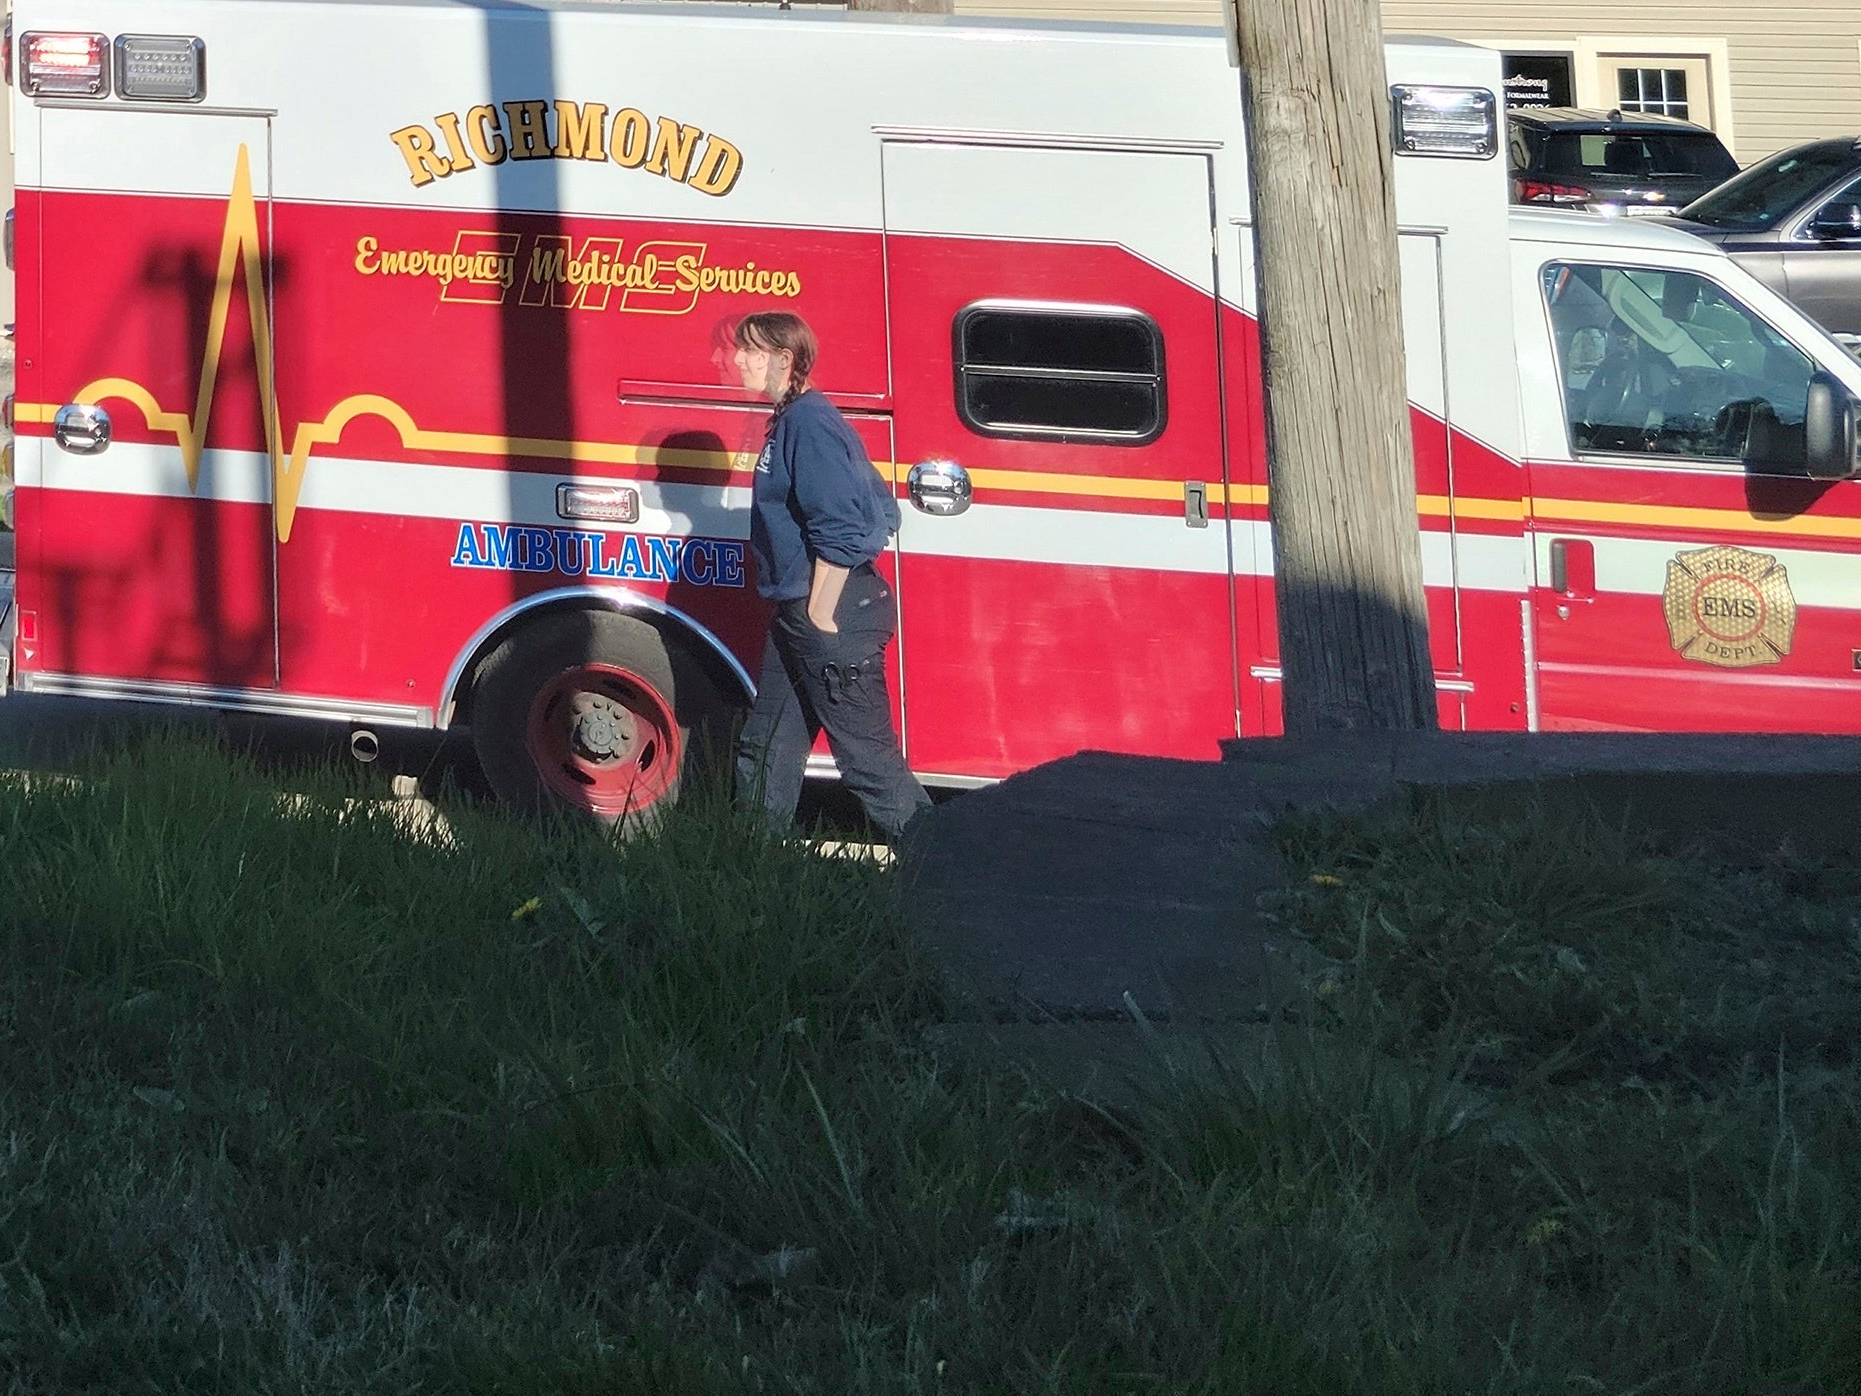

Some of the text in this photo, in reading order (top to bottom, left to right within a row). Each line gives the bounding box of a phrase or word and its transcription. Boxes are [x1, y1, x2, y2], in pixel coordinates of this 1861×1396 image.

[390, 99, 743, 197] RICHMOND
[354, 236, 802, 298] Emergency Medical Services
[440, 230, 708, 315] EMS
[450, 523, 745, 588] AMBULANCE
[1702, 559, 1751, 574] FIRE
[1702, 596, 1756, 618] EMS
[1704, 641, 1763, 660] DEPT.
